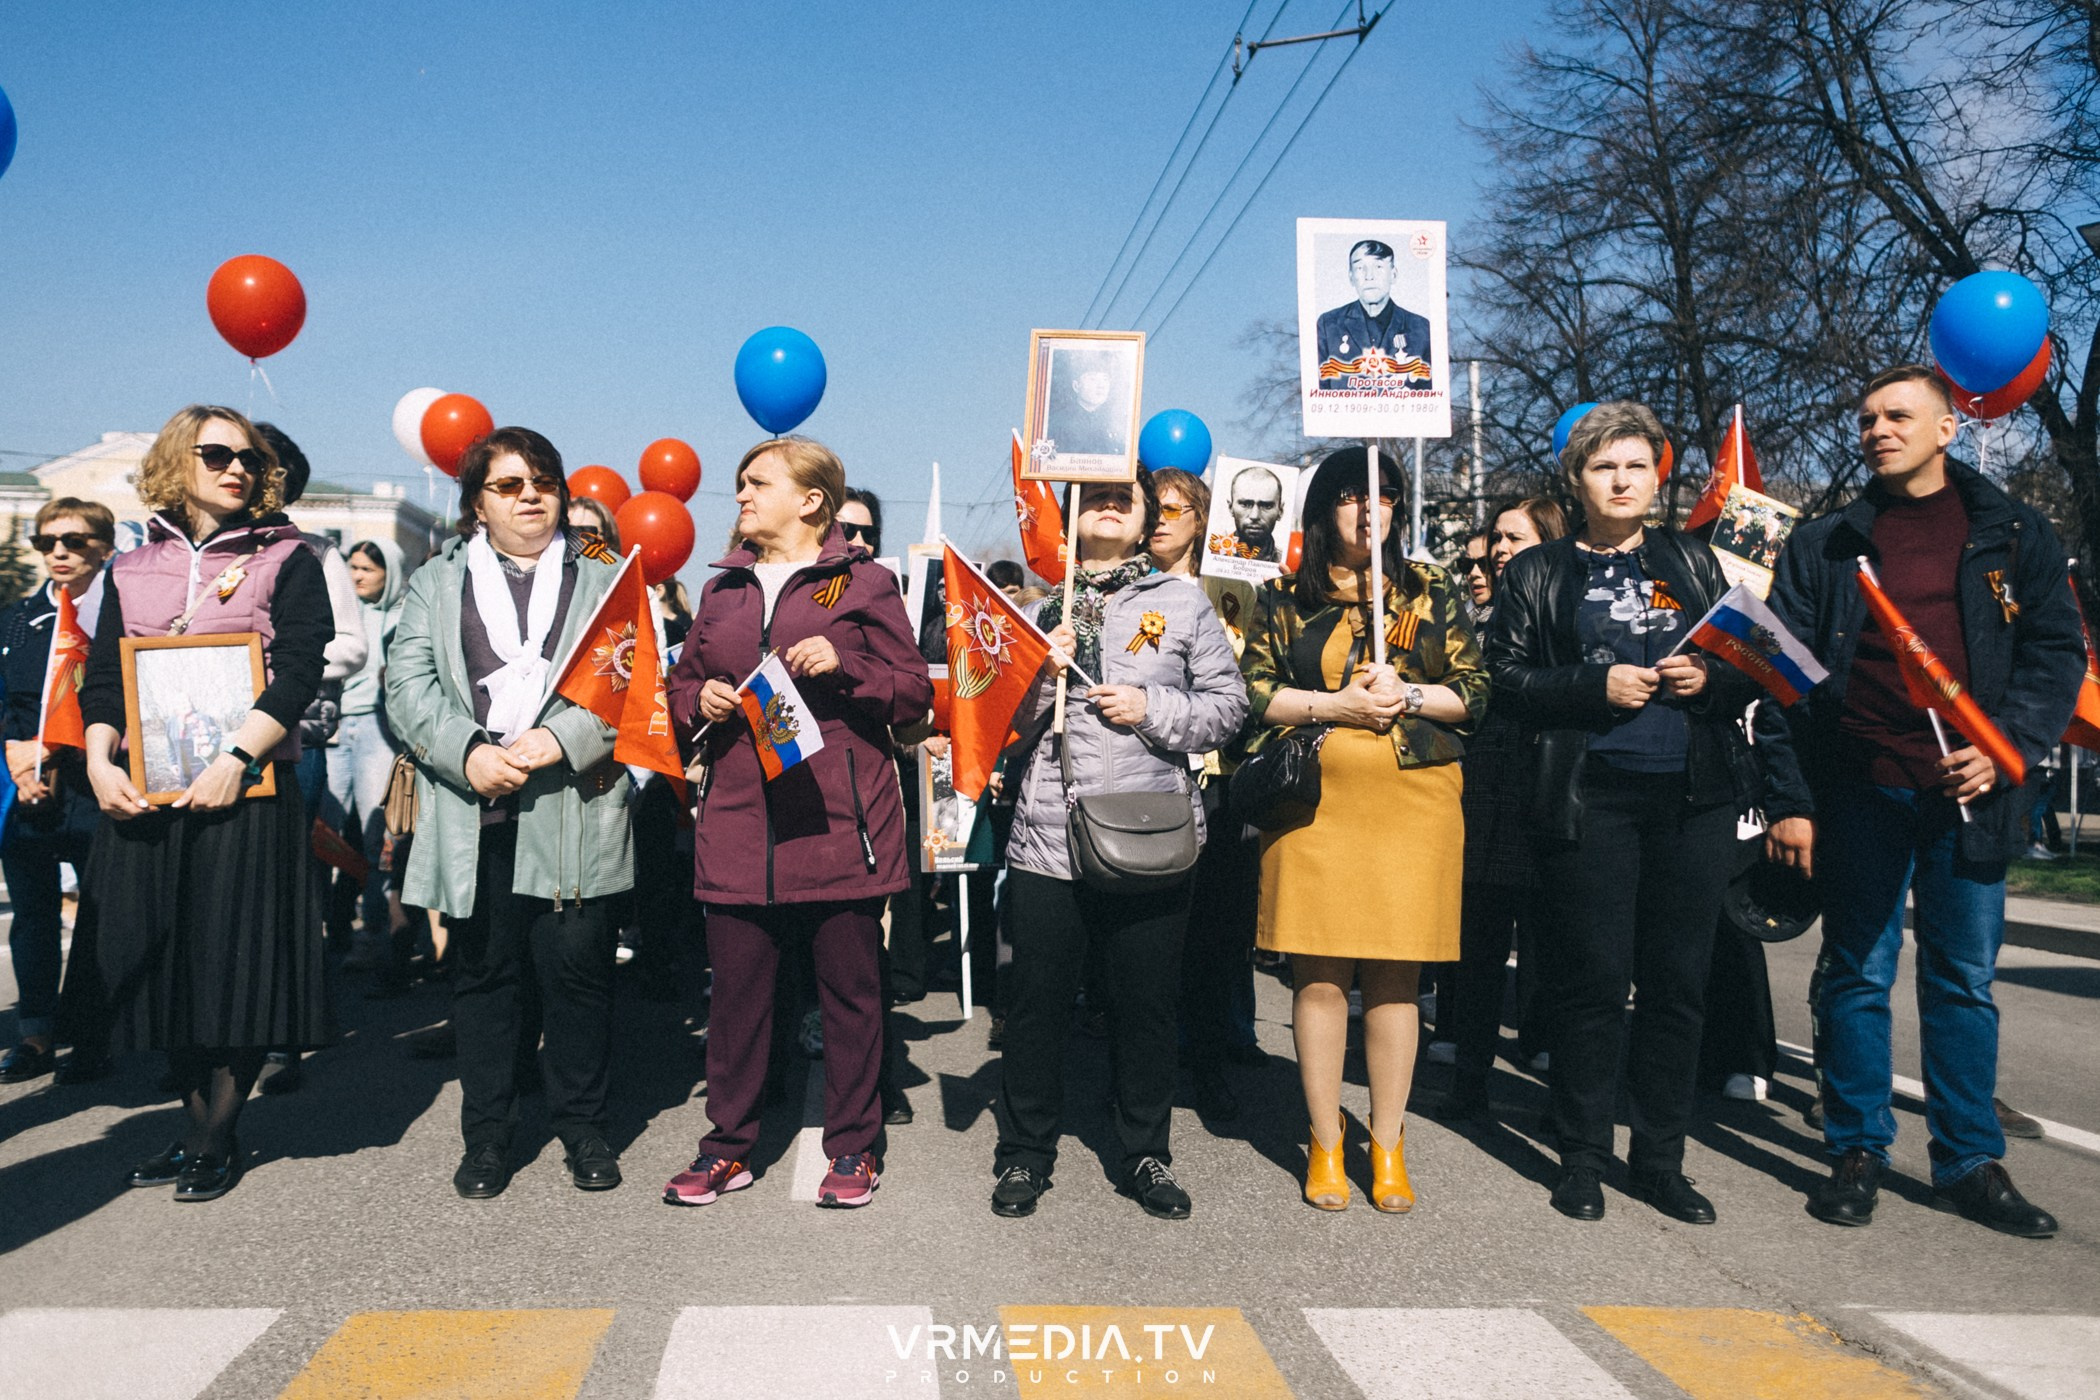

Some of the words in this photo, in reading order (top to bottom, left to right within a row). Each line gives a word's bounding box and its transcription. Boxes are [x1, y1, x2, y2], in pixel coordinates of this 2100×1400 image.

[1348, 377, 1404, 388] Протасов
[1309, 388, 1378, 399] Иннокентий
[1380, 388, 1444, 400] Андреевич
[1212, 555, 1247, 567] Александр
[1725, 638, 1774, 674] РОССИЯ
